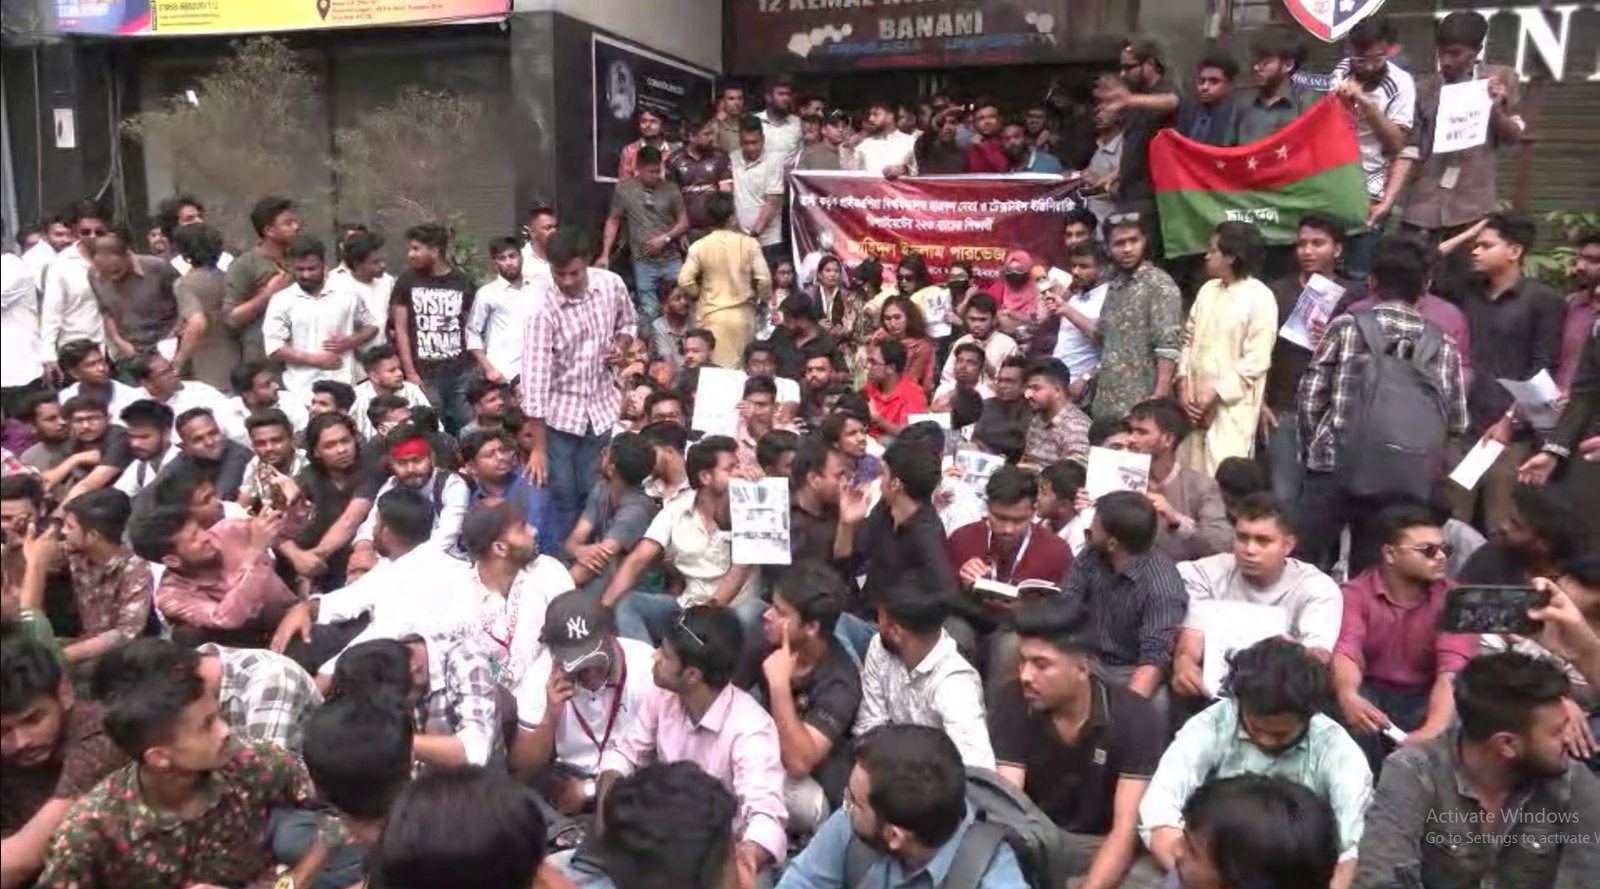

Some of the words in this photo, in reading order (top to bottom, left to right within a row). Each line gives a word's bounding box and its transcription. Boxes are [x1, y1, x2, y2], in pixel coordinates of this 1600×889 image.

[788, 0, 877, 12] KEM
[879, 11, 985, 40] BANANI
[950, 245, 1008, 262] পারভেজ
[411, 286, 464, 316] SYSTEM
[415, 314, 446, 332] OF
[566, 616, 590, 639] NY
